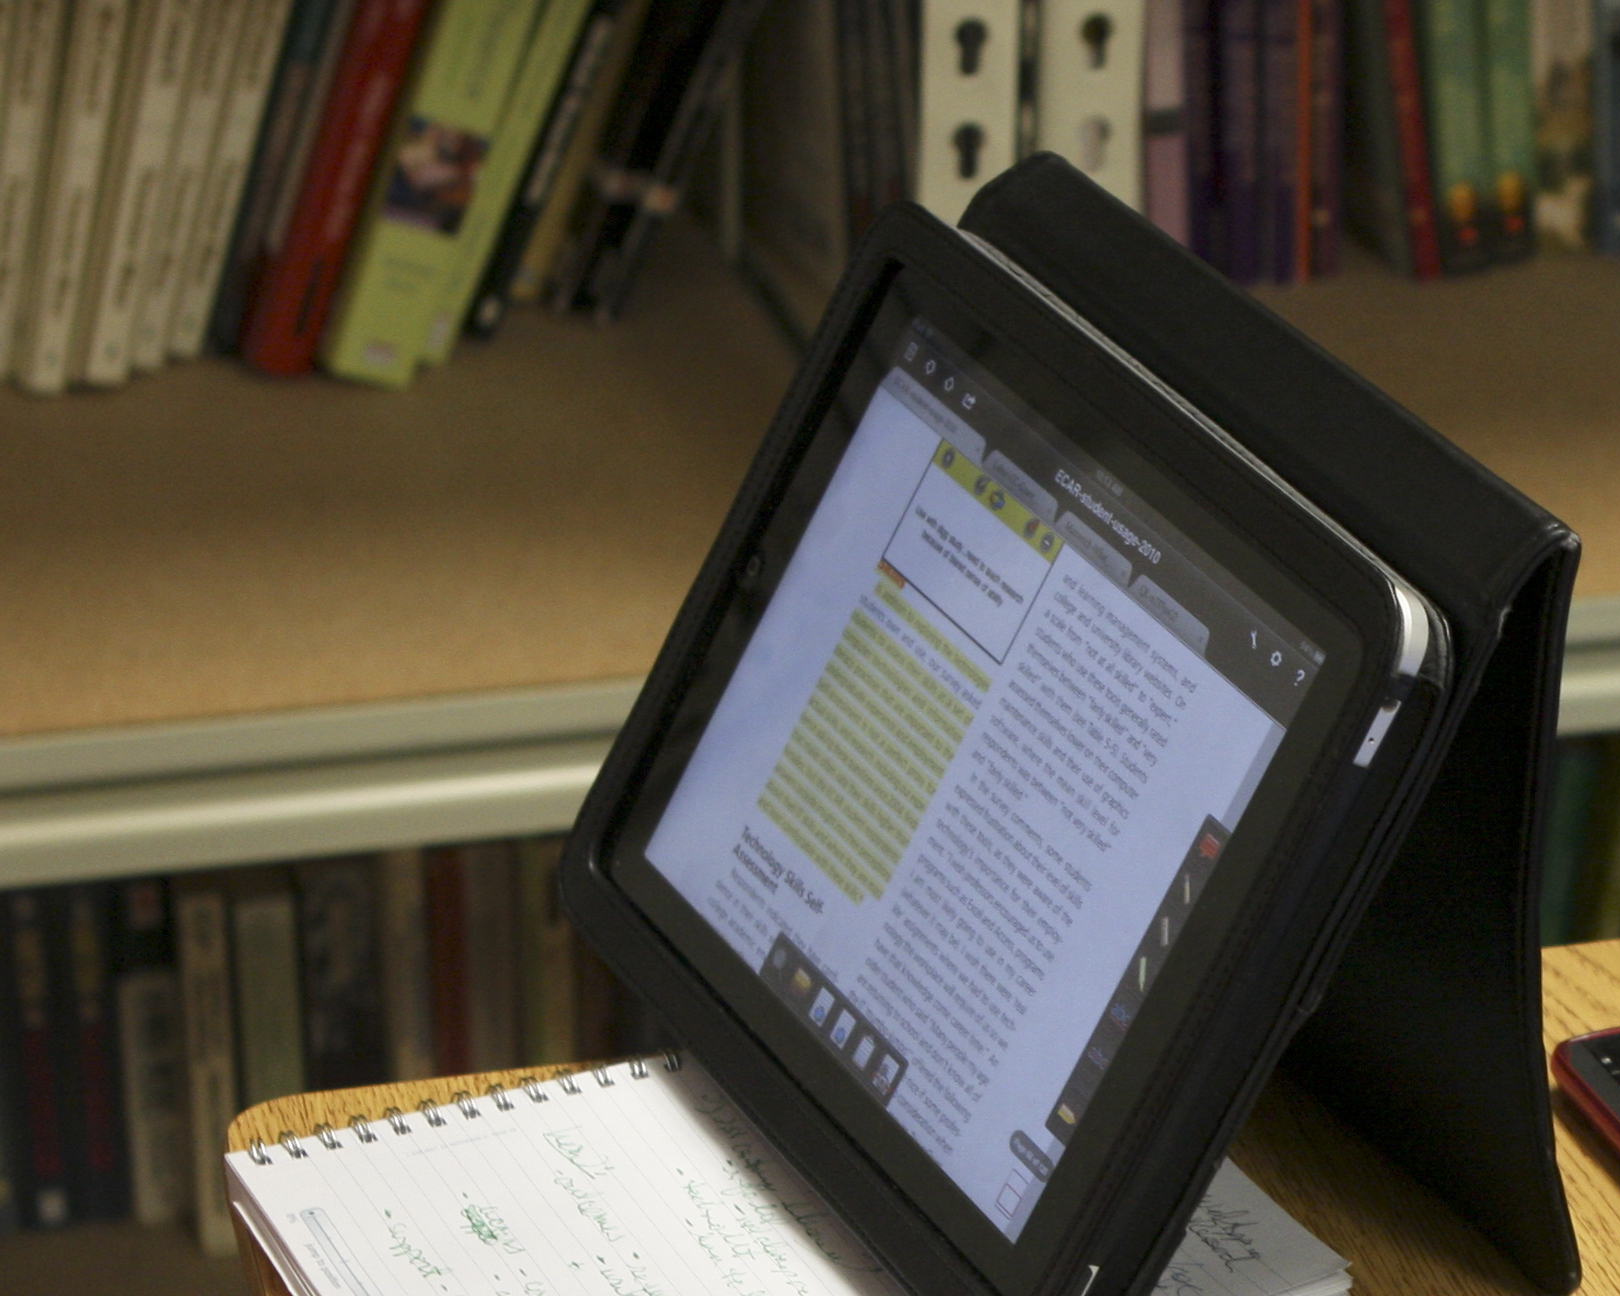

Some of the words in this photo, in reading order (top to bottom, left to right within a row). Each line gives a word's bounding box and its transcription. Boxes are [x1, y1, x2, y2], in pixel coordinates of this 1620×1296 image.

[1053, 466, 1162, 568] ECAR-student-usage-2010
[1075, 584, 1106, 617] learning
[1103, 608, 1150, 656] management
[1180, 675, 1196, 694] and
[731, 841, 779, 895] Assessment
[738, 824, 787, 880] Technology
[783, 868, 807, 898] Skills
[803, 888, 826, 917] Self-
